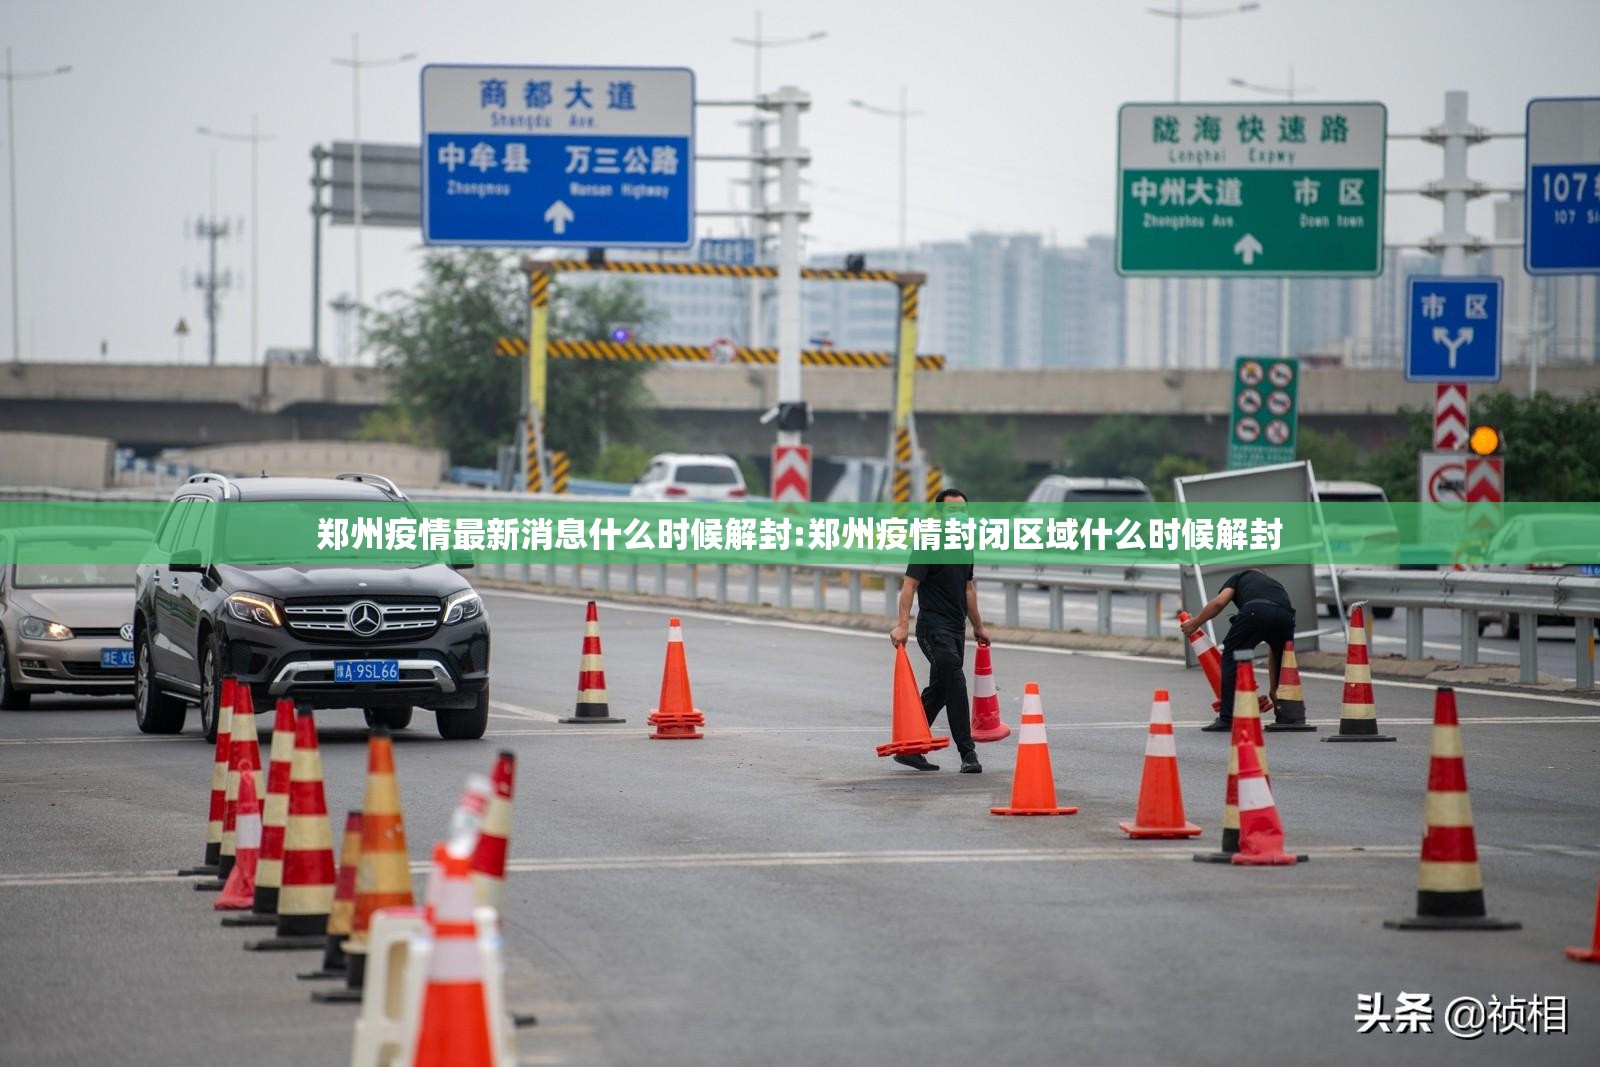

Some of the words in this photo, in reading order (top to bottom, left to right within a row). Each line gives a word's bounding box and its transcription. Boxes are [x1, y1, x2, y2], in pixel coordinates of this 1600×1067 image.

[479, 79, 636, 110] 商都大道
[1152, 114, 1349, 144] 陇海快速路
[438, 141, 531, 173] 中牟县
[565, 145, 678, 175] 万三公路
[1168, 148, 1227, 167] Longhai
[1131, 176, 1243, 207] 中州大道
[1293, 176, 1364, 207] 市区
[1554, 208, 1577, 225] 107
[1421, 293, 1488, 320] 市区
